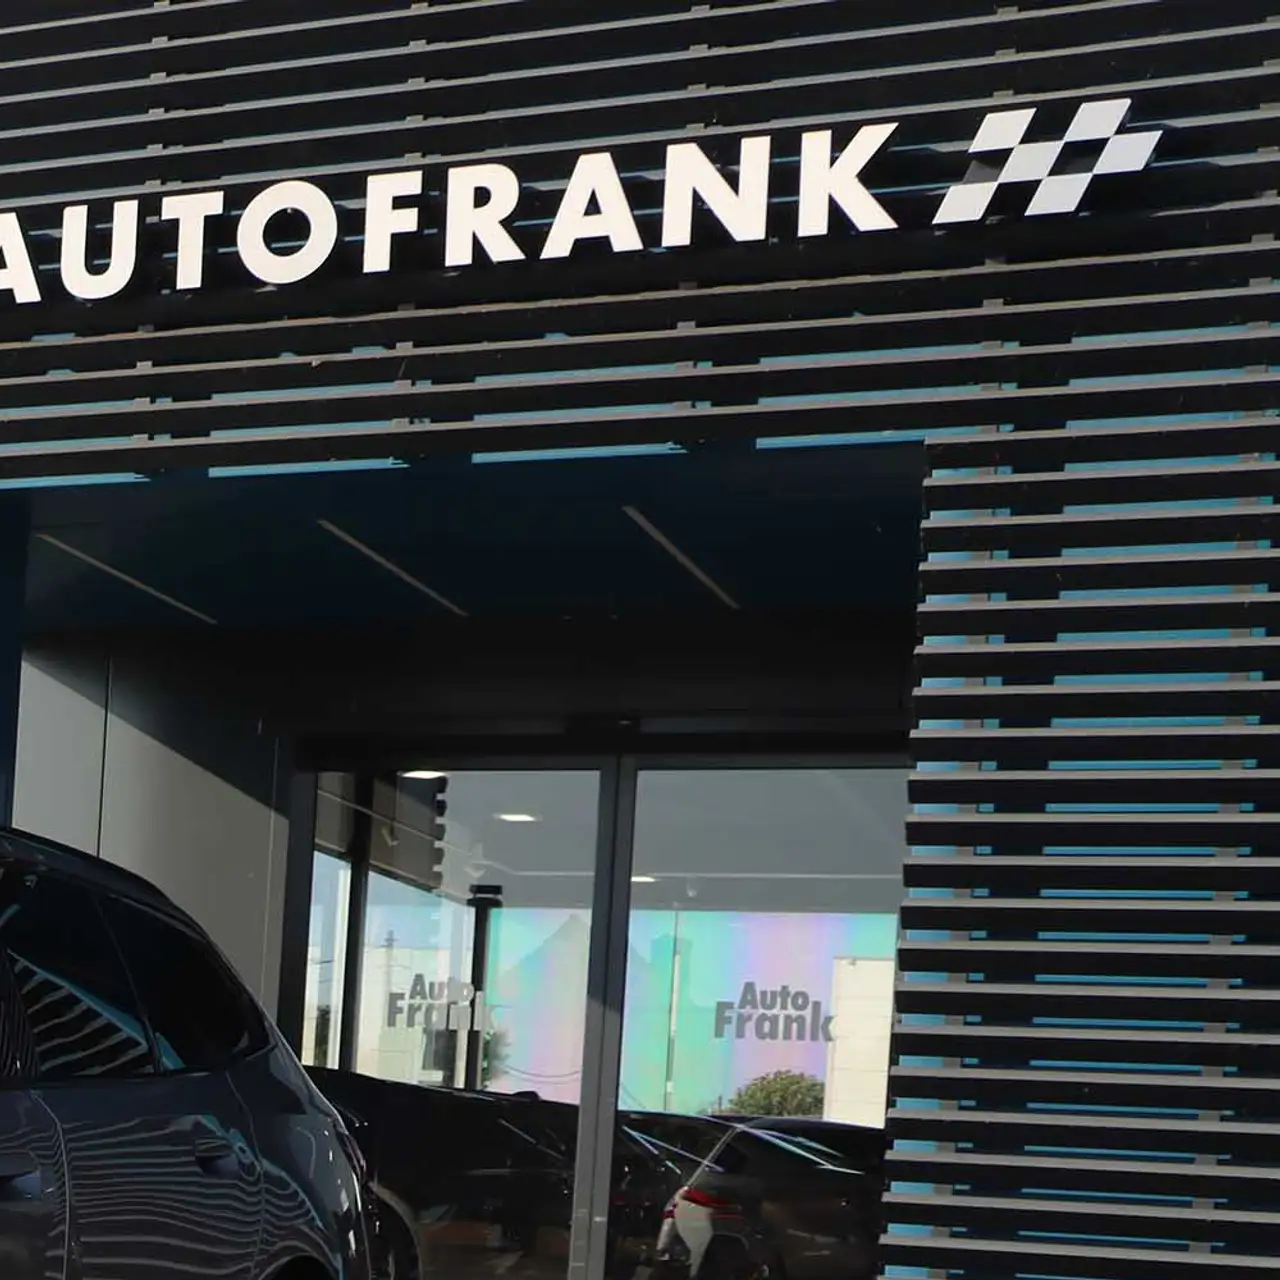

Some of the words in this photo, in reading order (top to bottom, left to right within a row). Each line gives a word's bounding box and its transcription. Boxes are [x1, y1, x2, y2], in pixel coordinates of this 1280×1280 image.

[409, 973, 475, 1002] Auto
[738, 981, 810, 1011] Auto
[715, 1000, 836, 1042] Frank
